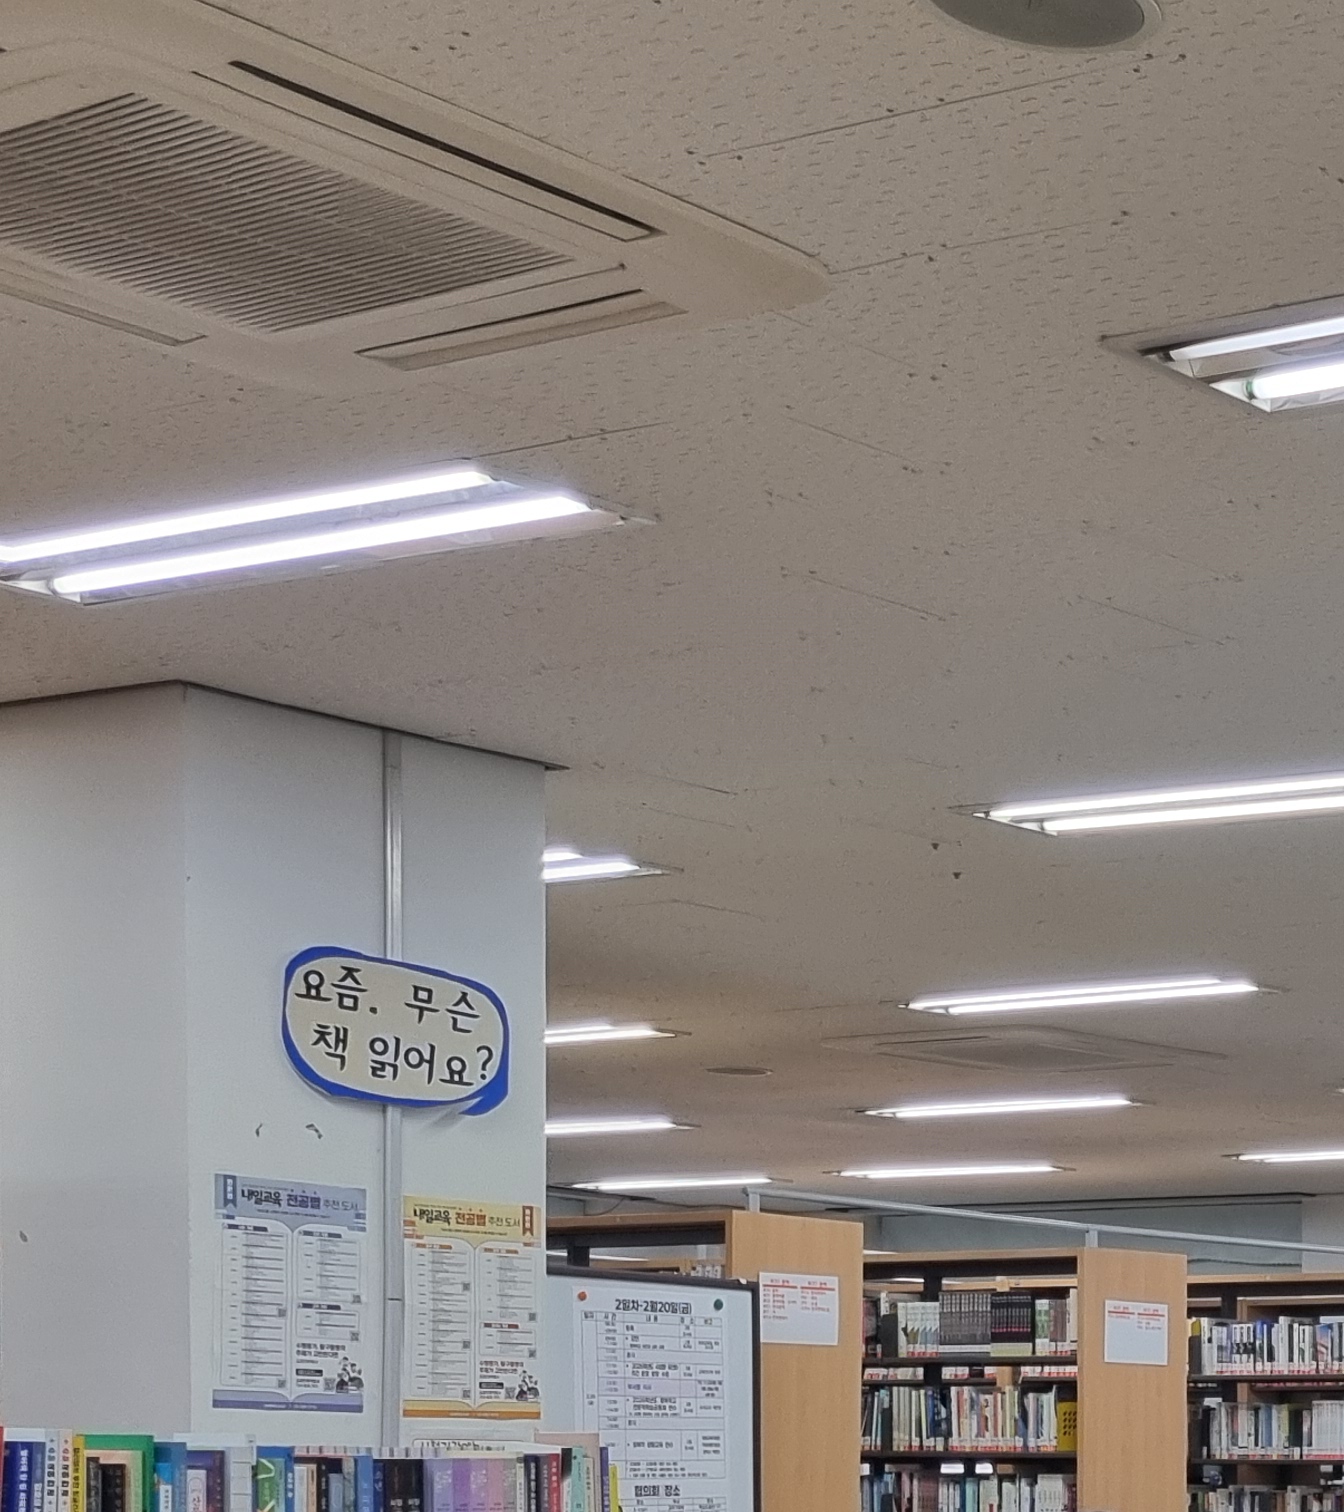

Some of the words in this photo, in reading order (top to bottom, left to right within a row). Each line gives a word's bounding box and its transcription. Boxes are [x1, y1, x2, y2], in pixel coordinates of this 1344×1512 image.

[404, 984, 480, 1034] 무슨
[311, 1022, 349, 1071] 책
[368, 1035, 494, 1086] 읽어요?
[241, 1189, 282, 1207] 내일교육
[286, 1193, 321, 1209] 전공별
[323, 1199, 340, 1210] 추천
[341, 1200, 359, 1211] 도서
[413, 1208, 452, 1226] 내일교육
[455, 1211, 487, 1226] 전공별
[488, 1216, 503, 1227] 추천
[505, 1217, 520, 1227] 도서
[634, 1485, 660, 1497] 협의회
[664, 1485, 681, 1497] 장소
